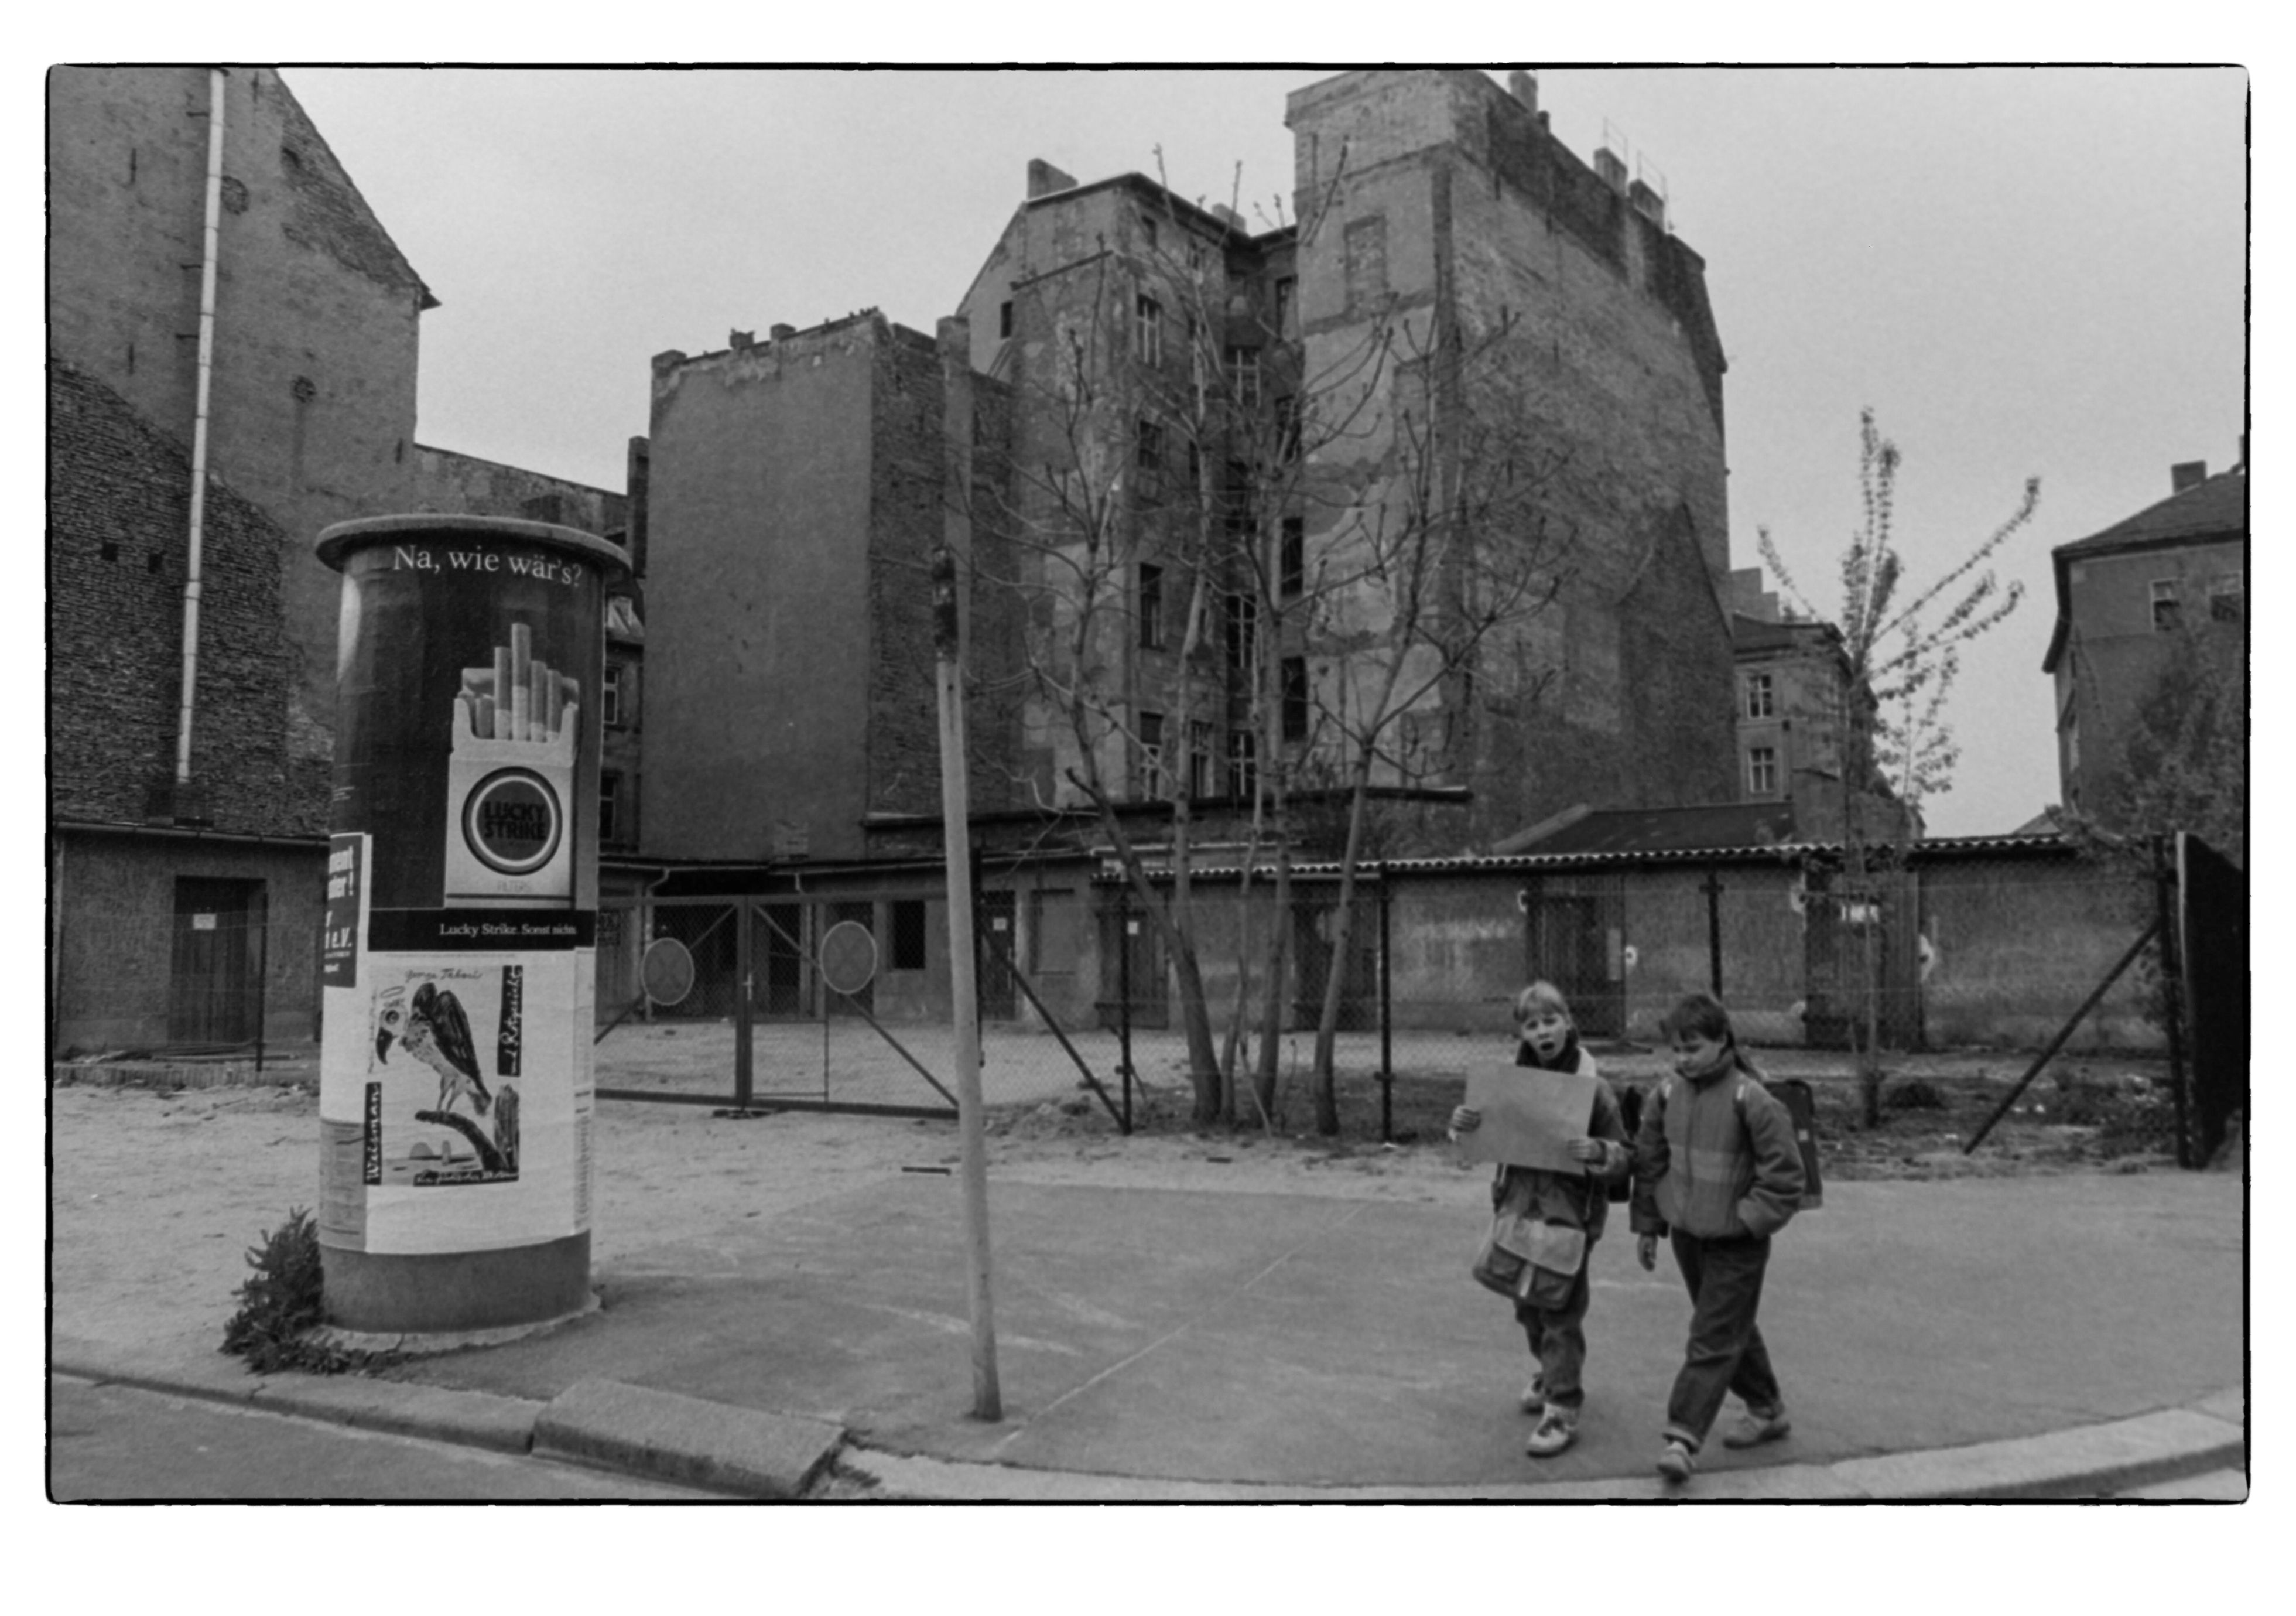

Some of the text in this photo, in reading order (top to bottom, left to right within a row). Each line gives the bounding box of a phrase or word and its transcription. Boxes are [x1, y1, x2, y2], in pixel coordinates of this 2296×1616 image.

[393, 545, 583, 587] Na, wie wär's?
[484, 802, 546, 821] LUCKY
[484, 821, 546, 841] STRIKE
[439, 923, 479, 938] Lucky
